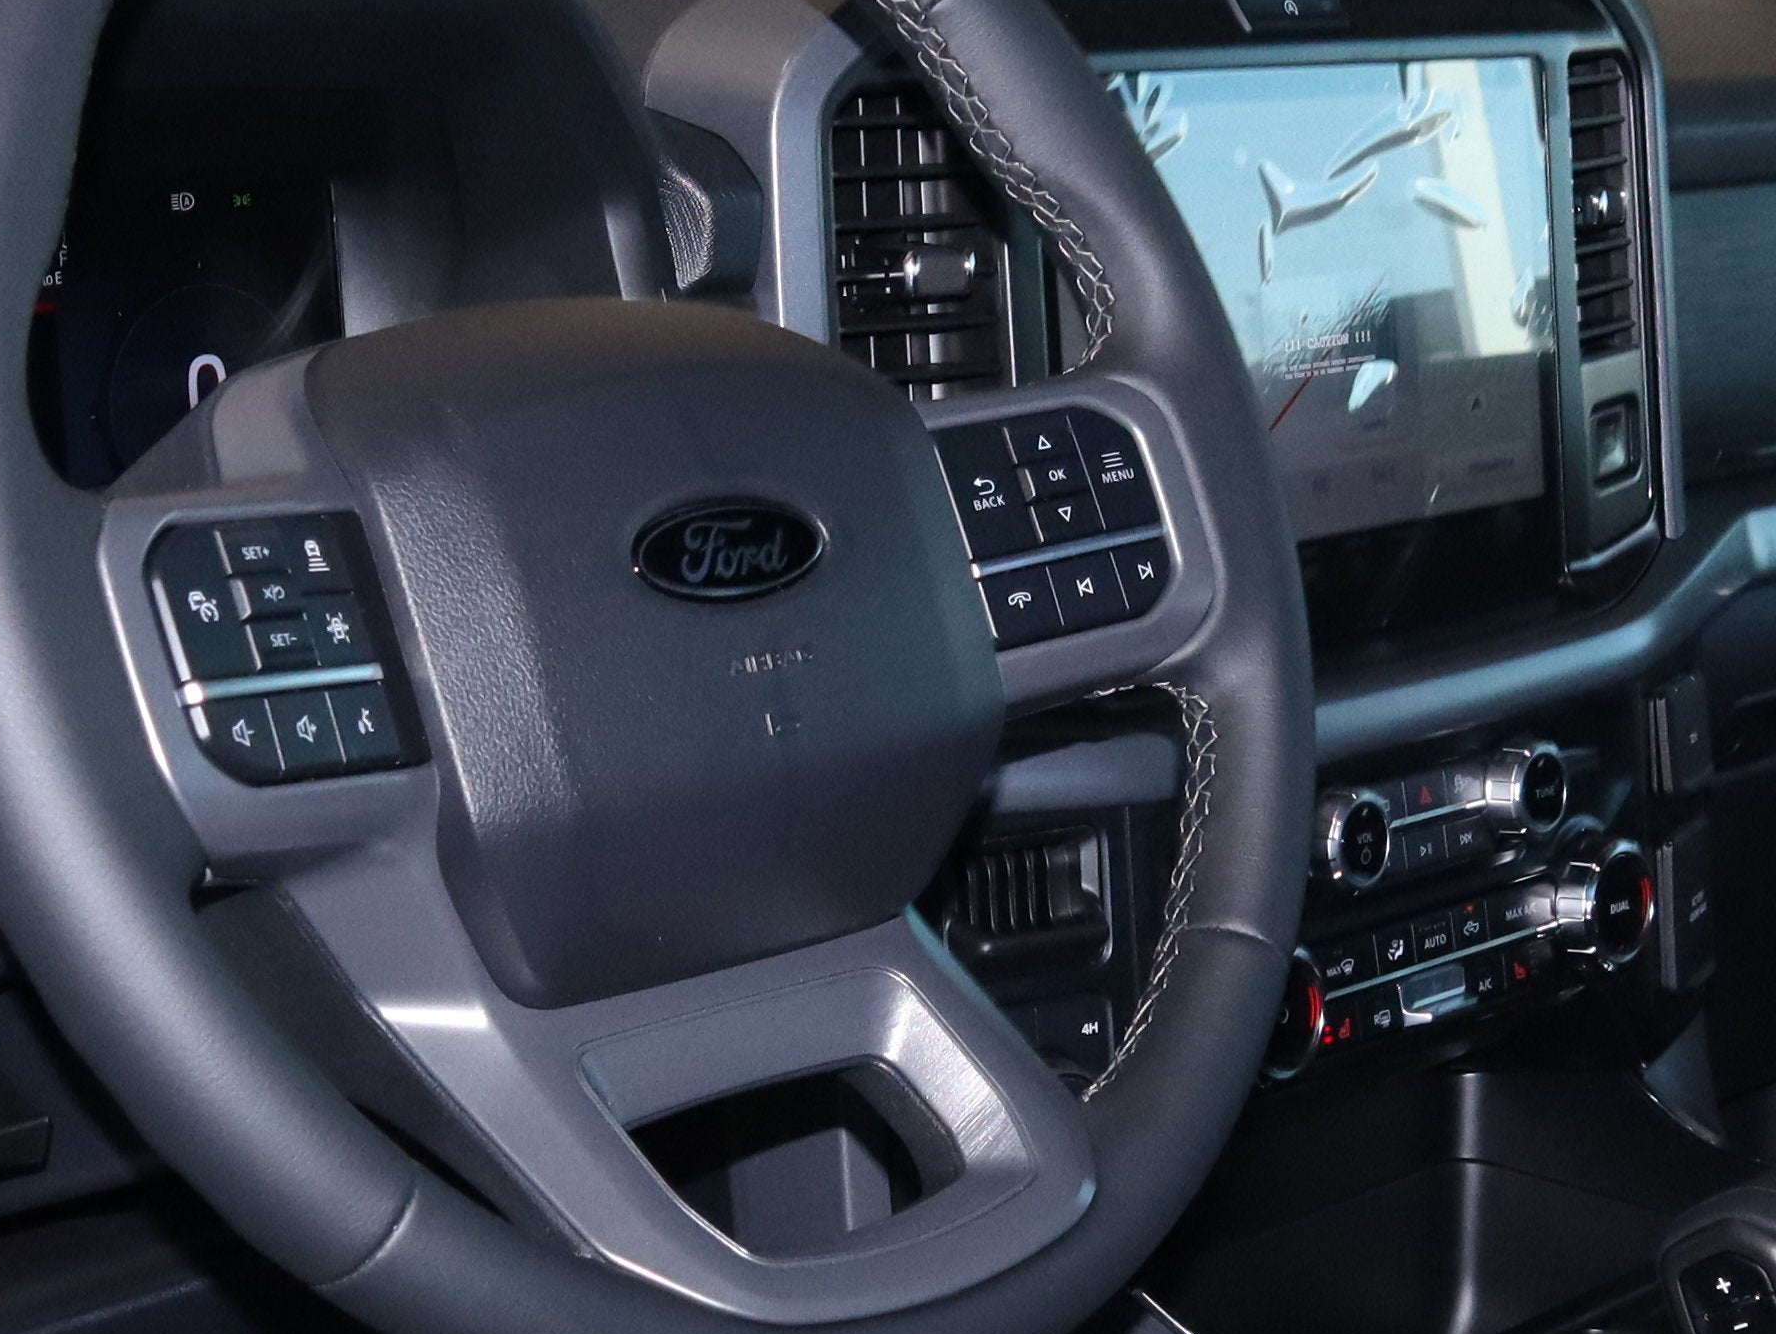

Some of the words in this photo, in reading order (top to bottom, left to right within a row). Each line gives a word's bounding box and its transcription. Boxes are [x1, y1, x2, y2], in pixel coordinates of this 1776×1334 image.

[1048, 469, 1067, 482] OK
[1101, 468, 1134, 484] MENU
[972, 494, 1006, 512] BACK
[680, 517, 788, 585] Ford
[1505, 907, 1523, 921] MAX
[1610, 900, 1630, 915] DUAL
[1423, 933, 1447, 950] AUTO
[1478, 977, 1493, 992] A/C
[1080, 1021, 1099, 1036] 4H
